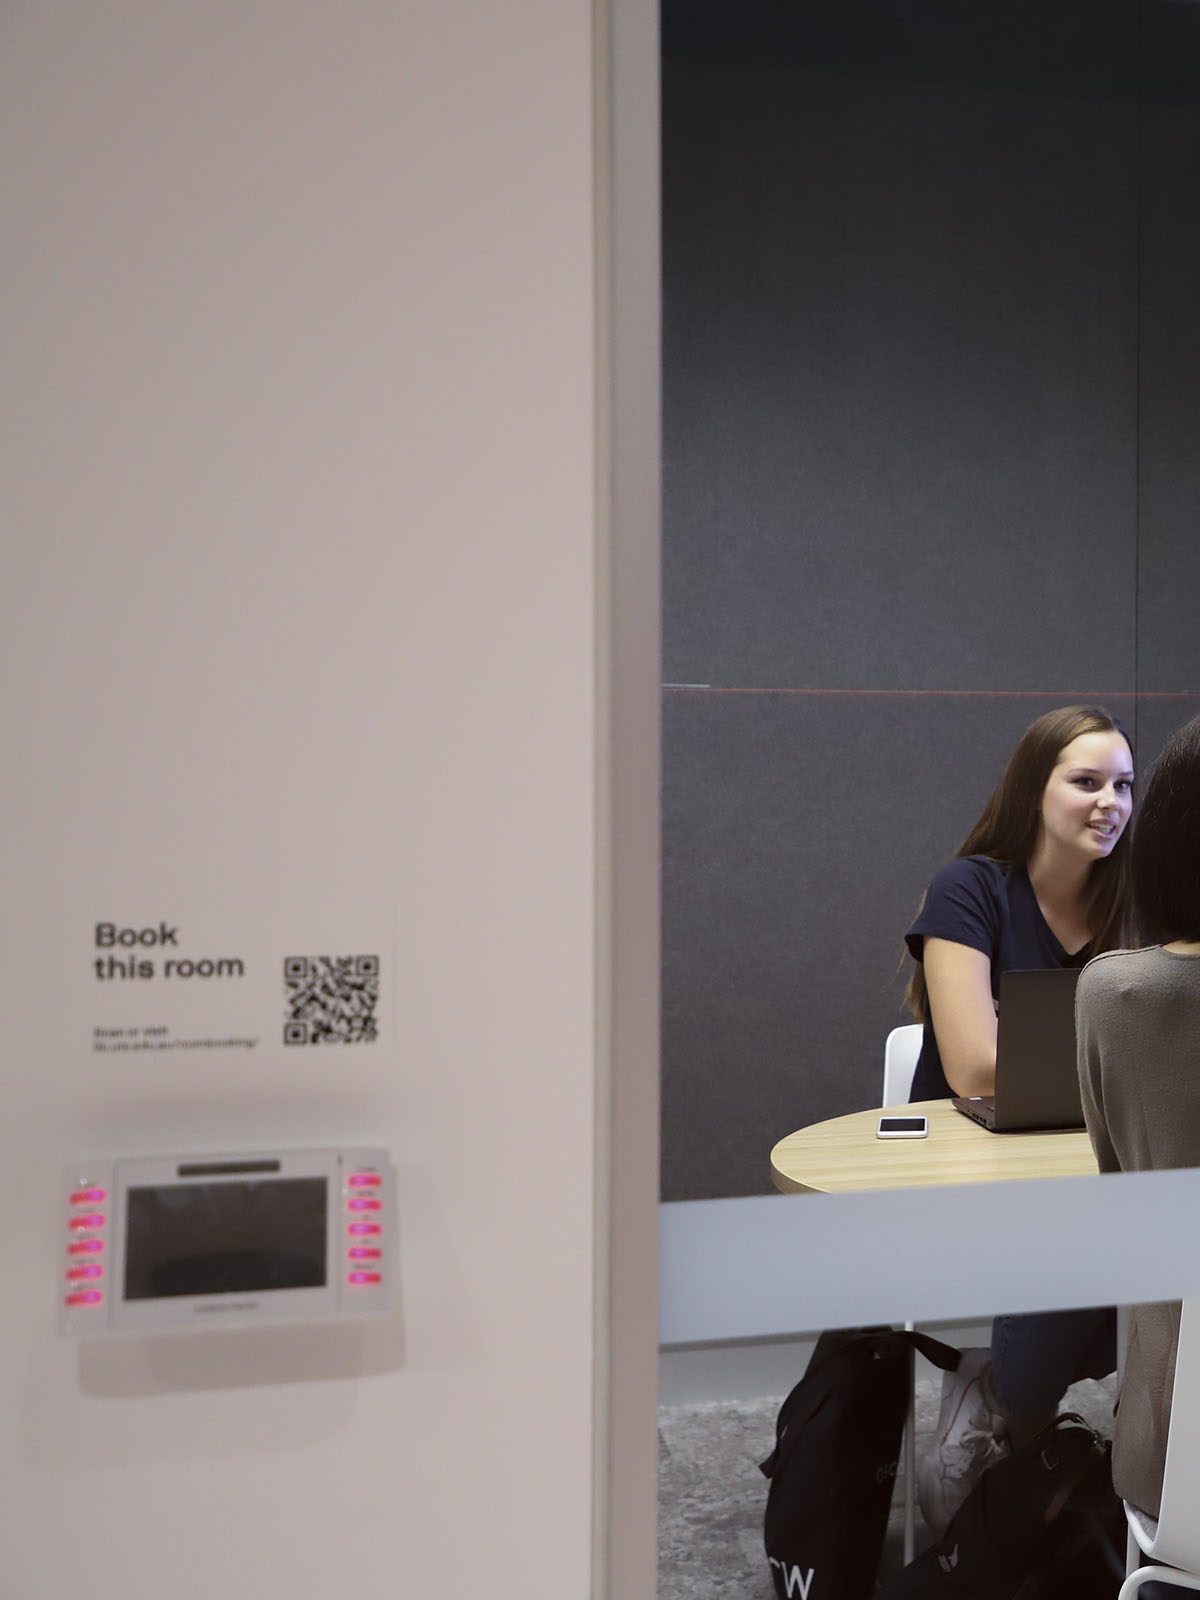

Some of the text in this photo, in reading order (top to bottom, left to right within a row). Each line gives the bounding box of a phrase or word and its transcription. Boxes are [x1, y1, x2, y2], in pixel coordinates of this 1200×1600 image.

[95, 922, 179, 948] Book
[94, 955, 245, 980] this room
